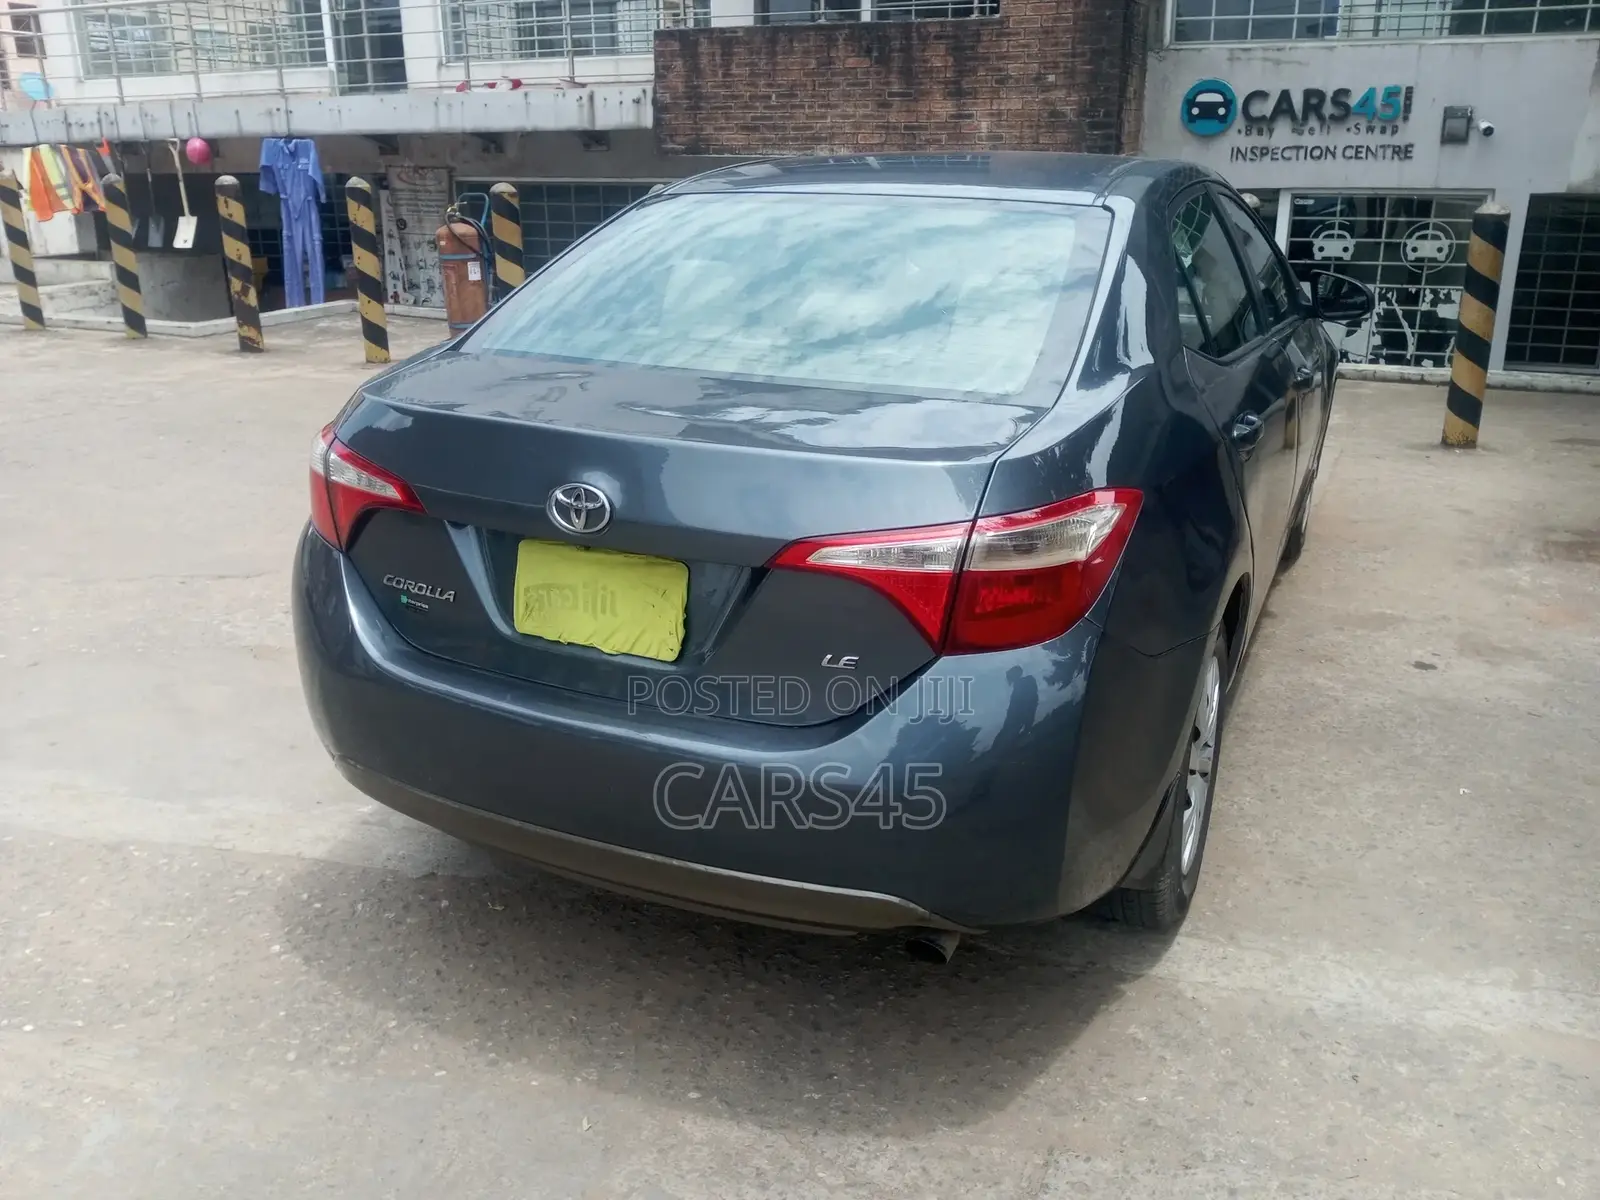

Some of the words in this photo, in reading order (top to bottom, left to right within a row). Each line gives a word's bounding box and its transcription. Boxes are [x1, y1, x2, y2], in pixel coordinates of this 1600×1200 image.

[1241, 86, 1402, 122] CARS45
[1230, 145, 1337, 162] INSPECTION
[1342, 144, 1415, 161] CENTRE
[383, 574, 455, 602] COROLLA
[821, 654, 861, 669] LE
